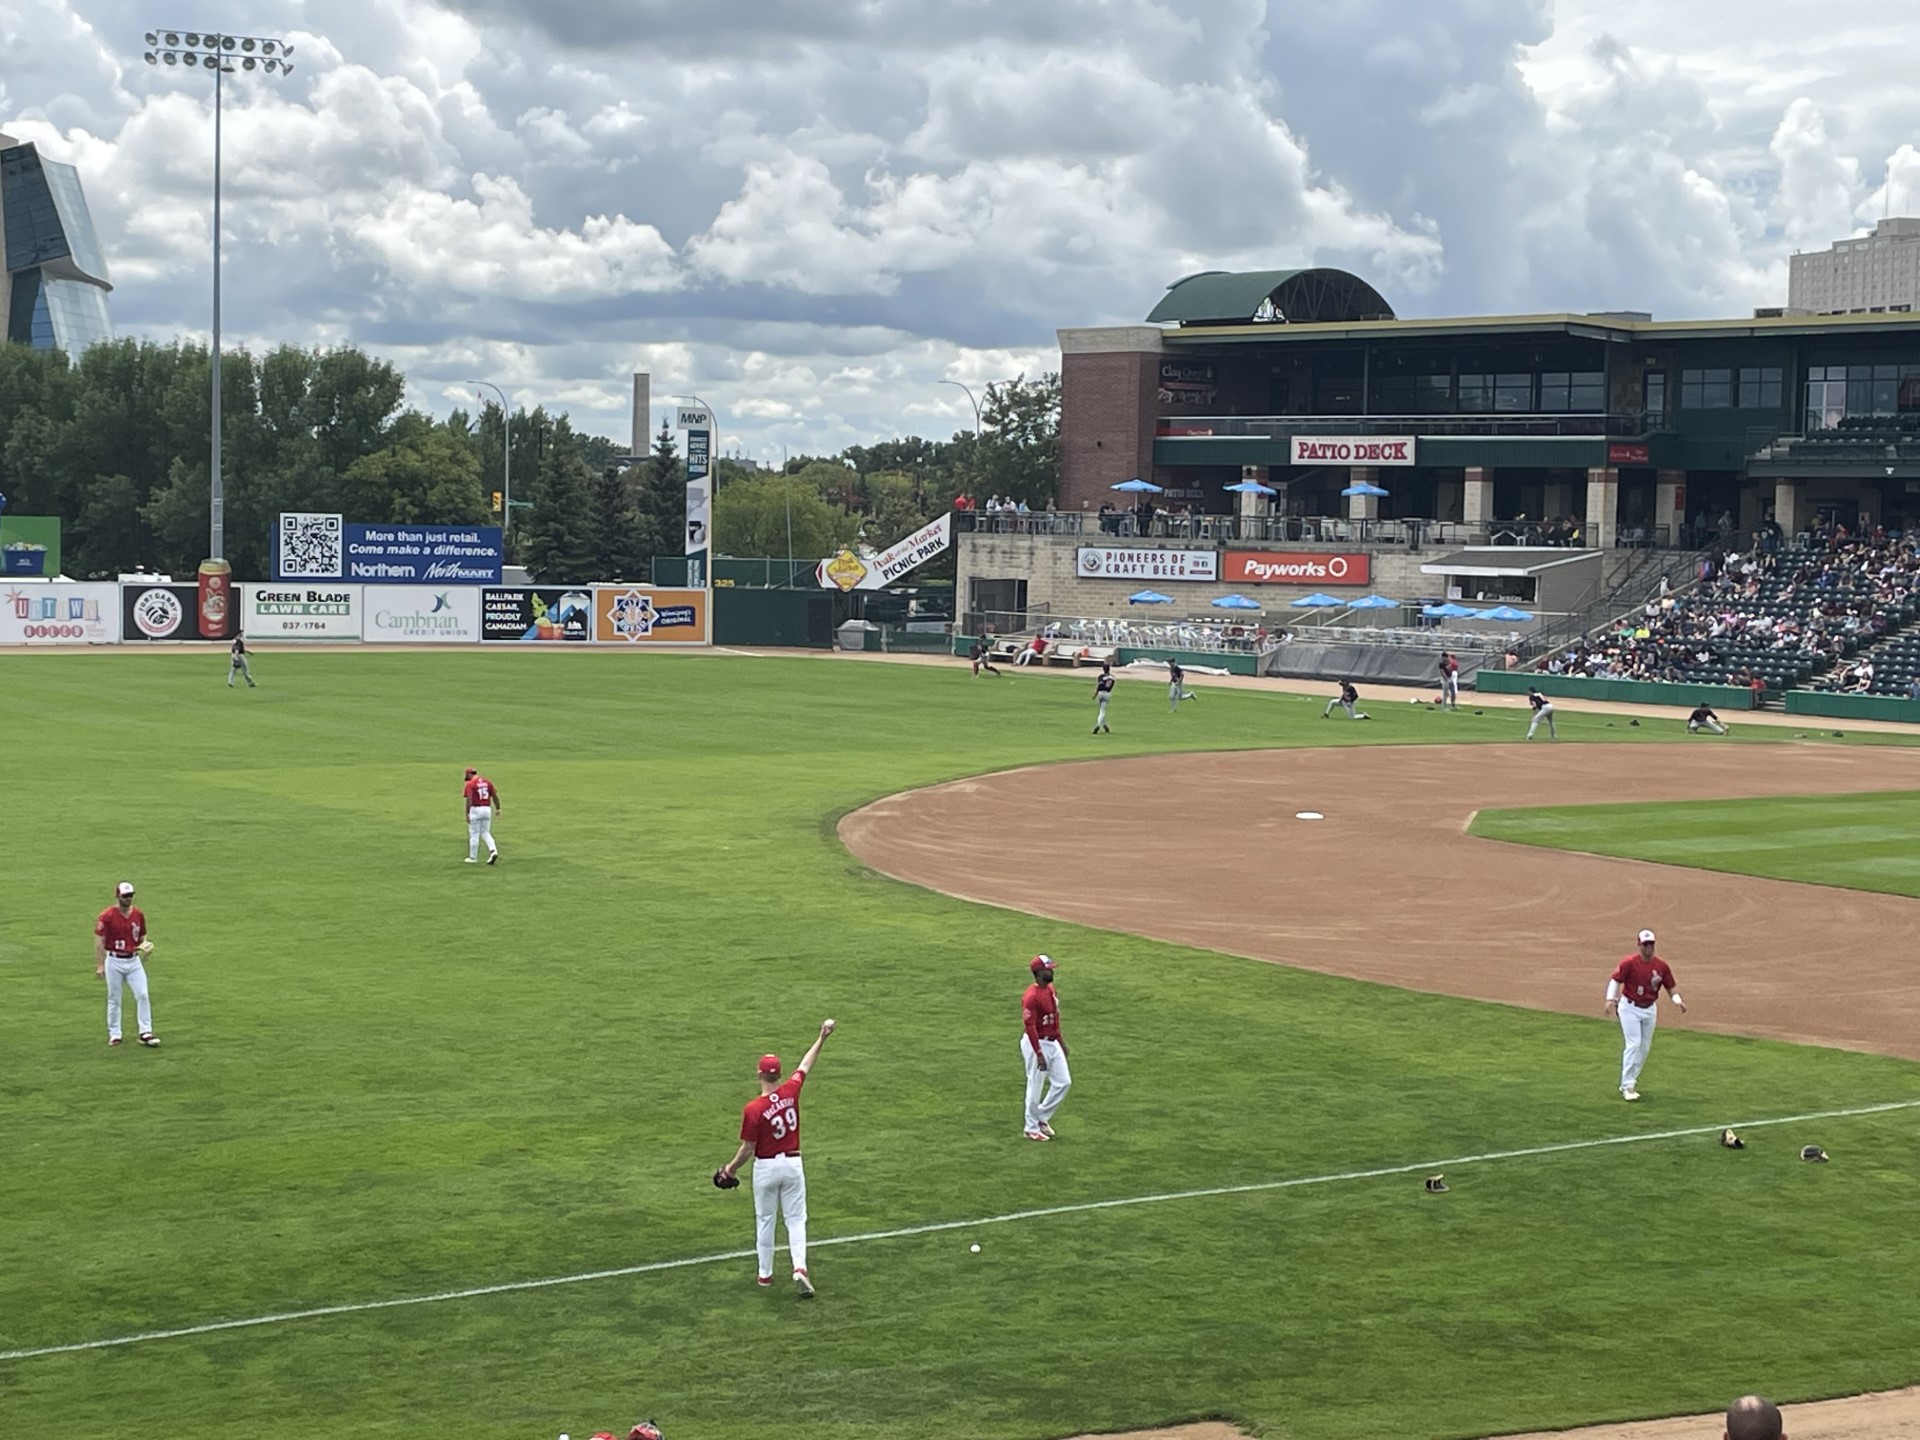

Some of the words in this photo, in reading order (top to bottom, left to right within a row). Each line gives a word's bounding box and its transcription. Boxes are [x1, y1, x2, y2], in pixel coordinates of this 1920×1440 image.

[681, 412, 707, 424] MNP
[1298, 442, 1350, 460] PATIO
[1353, 442, 1408, 460] DECK
[689, 454, 707, 464] HITS
[366, 530, 395, 541] More
[397, 531, 422, 541] than
[425, 532, 447, 543] just
[450, 532, 481, 543] retail.
[349, 544, 384, 554] Come
[387, 545, 420, 555] make
[423, 547, 430, 555] a
[434, 545, 498, 556] difference.
[882, 553, 917, 580] PICNIC
[916, 537, 945, 559] PARK
[1106, 552, 1165, 564] PIONEERS
[1171, 554, 1186, 564] OF
[351, 562, 415, 577] Northern
[1105, 564, 1146, 574] CRAFT
[1153, 565, 1185, 575] BEER
[1244, 560, 1327, 579] Payworks
[714, 579, 735, 588] 325
[154, 592, 178, 612] GARRY
[18, 599, 98, 619] UPTOWN
[260, 604, 303, 614] LAWN
[308, 605, 346, 614] CARE
[375, 610, 458, 628] Cambrian
[485, 613, 521, 621] PROUDLY
[477, 787, 489, 800] 15
[771, 1107, 798, 1139] 39
